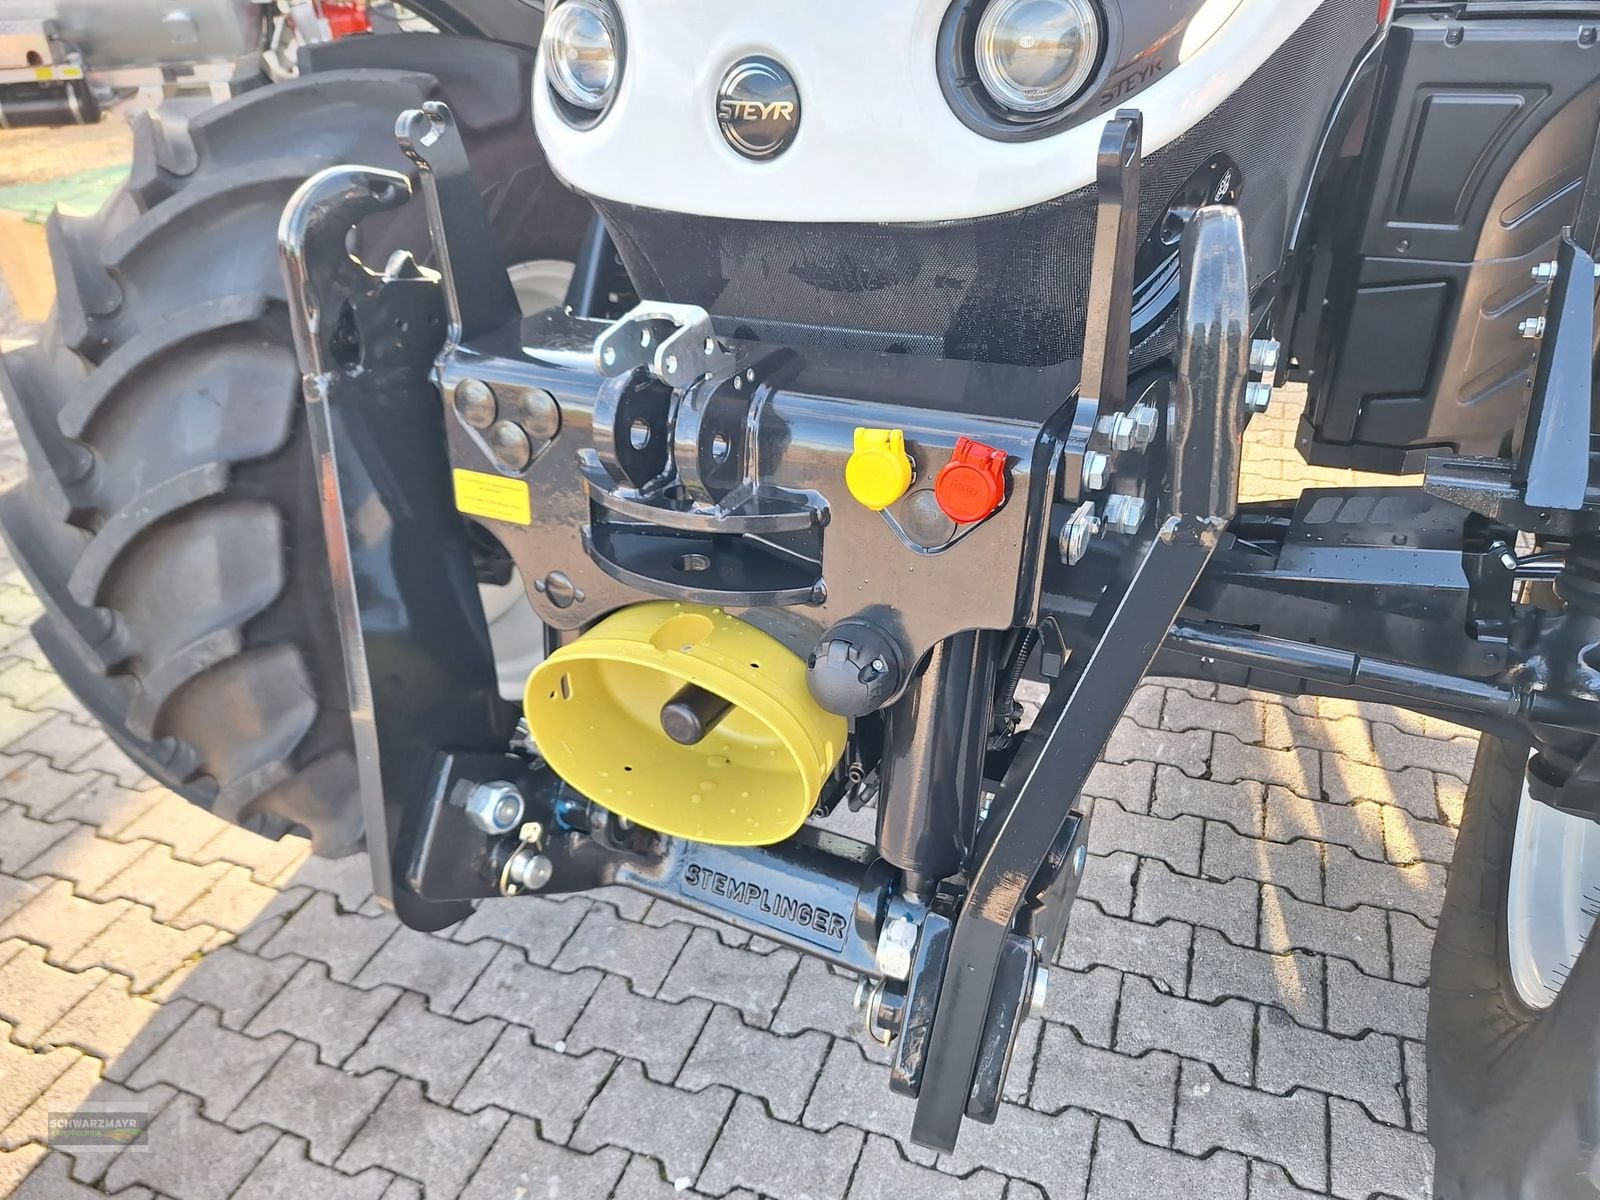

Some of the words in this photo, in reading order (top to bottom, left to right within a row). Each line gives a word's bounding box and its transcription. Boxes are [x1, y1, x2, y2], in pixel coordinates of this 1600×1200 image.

[1099, 55, 1162, 107] STEYR
[718, 99, 794, 121] STEYR
[685, 863, 848, 939] STEMPLINGER
